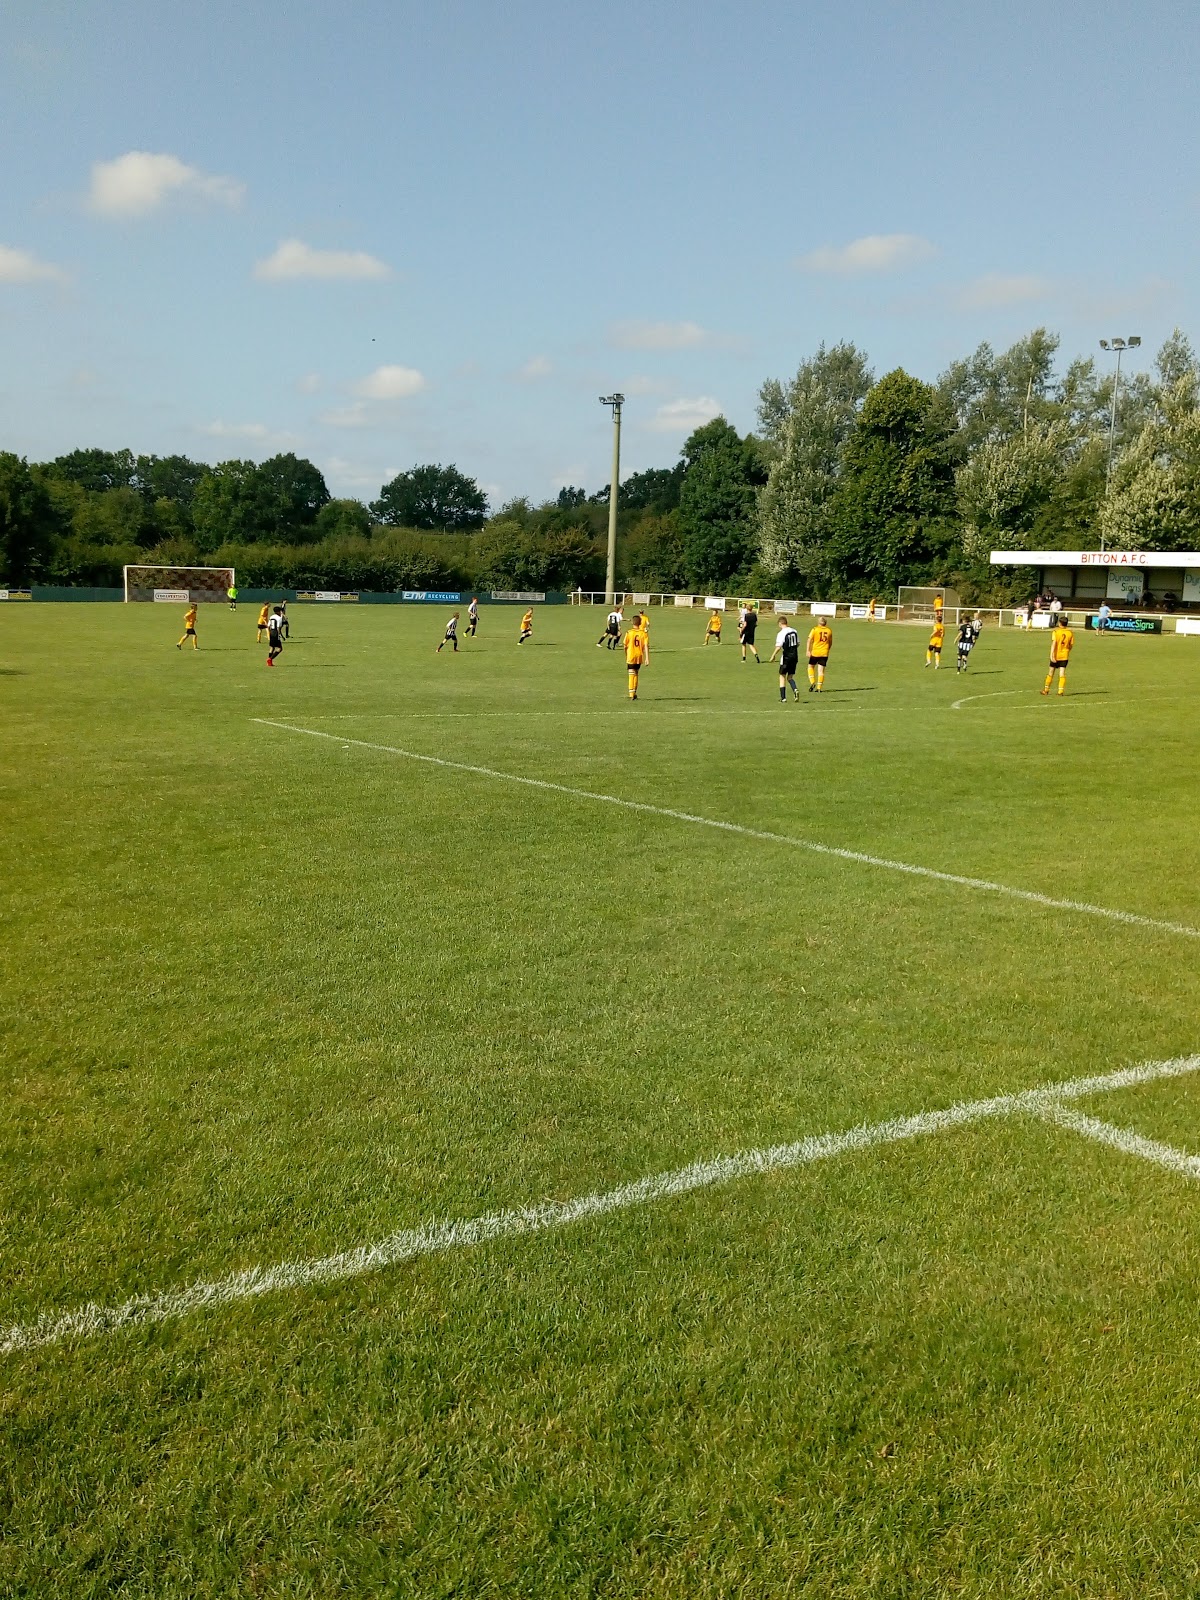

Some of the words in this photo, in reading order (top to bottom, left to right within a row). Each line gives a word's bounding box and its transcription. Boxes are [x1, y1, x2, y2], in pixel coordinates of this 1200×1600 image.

[1081, 554, 1118, 564] BITTON
[1120, 554, 1149, 565] A.F.C.
[1108, 573, 1143, 584] Dynamic
[1120, 582, 1142, 593] Signs
[819, 631, 828, 643] 15
[965, 627, 971, 638] 5
[634, 634, 640, 647] 6
[787, 633, 797, 648] 10
[1061, 633, 1067, 645] 2
